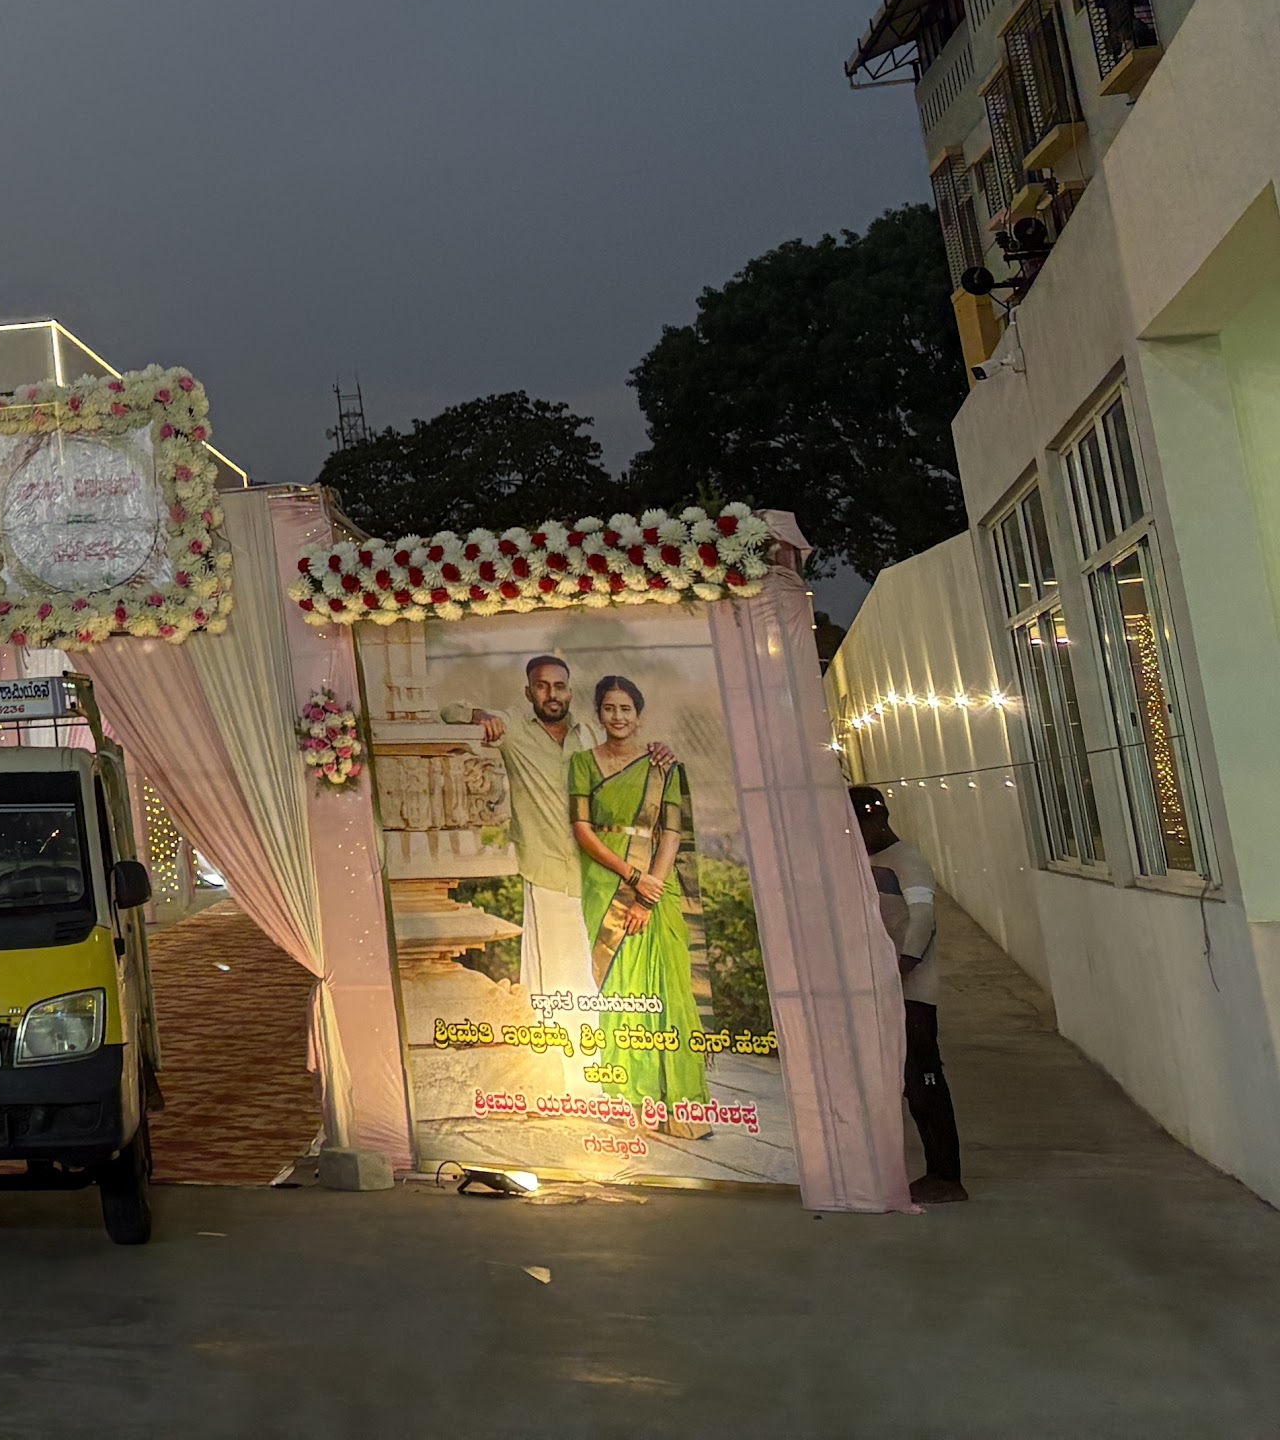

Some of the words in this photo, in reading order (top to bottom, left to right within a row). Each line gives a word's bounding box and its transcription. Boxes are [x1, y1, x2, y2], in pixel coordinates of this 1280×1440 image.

[531, 990, 574, 1018] ಸ್ವಾಗತ
[578, 992, 664, 1013] ಬಯಸುವವರು
[434, 1017, 495, 1050] ಶ್ರೀಮತಿ
[501, 1021, 575, 1058] ಇಂದ್ರಮ್ಮ
[580, 1023, 607, 1056] ಶ್ರೀ
[613, 1023, 680, 1052] ರಮೇಶ
[584, 1062, 629, 1085] ಹದಡಿ
[474, 1088, 528, 1118] ಶ್ರೀಮತಿ
[536, 1093, 638, 1127] ಯಶೋಧಮ್ಮ
[643, 1096, 668, 1129] ಶ್ರೀ
[674, 1098, 760, 1134] ಗದಿಗೇಶಪ್ಪ
[583, 1135, 648, 1160] ಗುತ್ತೂರು
